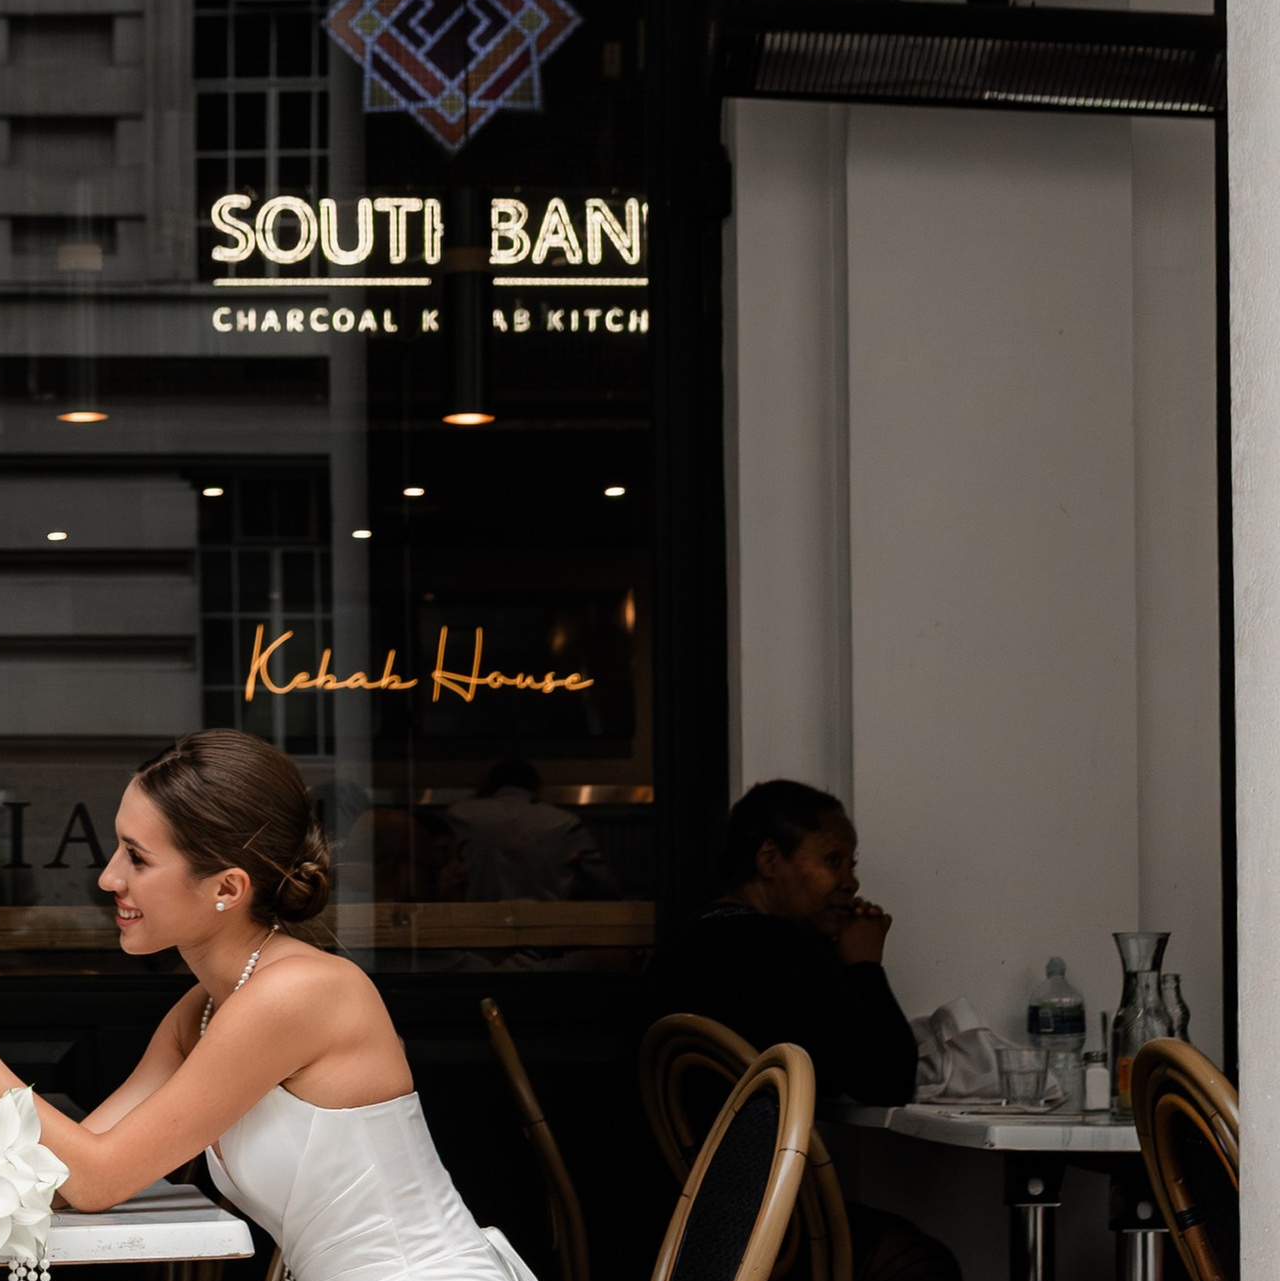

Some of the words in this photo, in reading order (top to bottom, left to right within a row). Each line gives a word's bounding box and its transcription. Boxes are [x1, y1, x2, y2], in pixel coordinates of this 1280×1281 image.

[488, 196, 649, 266] BAN
[211, 306, 399, 333] CHARCOAL
[421, 306, 531, 333] KAB
[244, 623, 419, 702] Kebab
[431, 625, 595, 703] House
